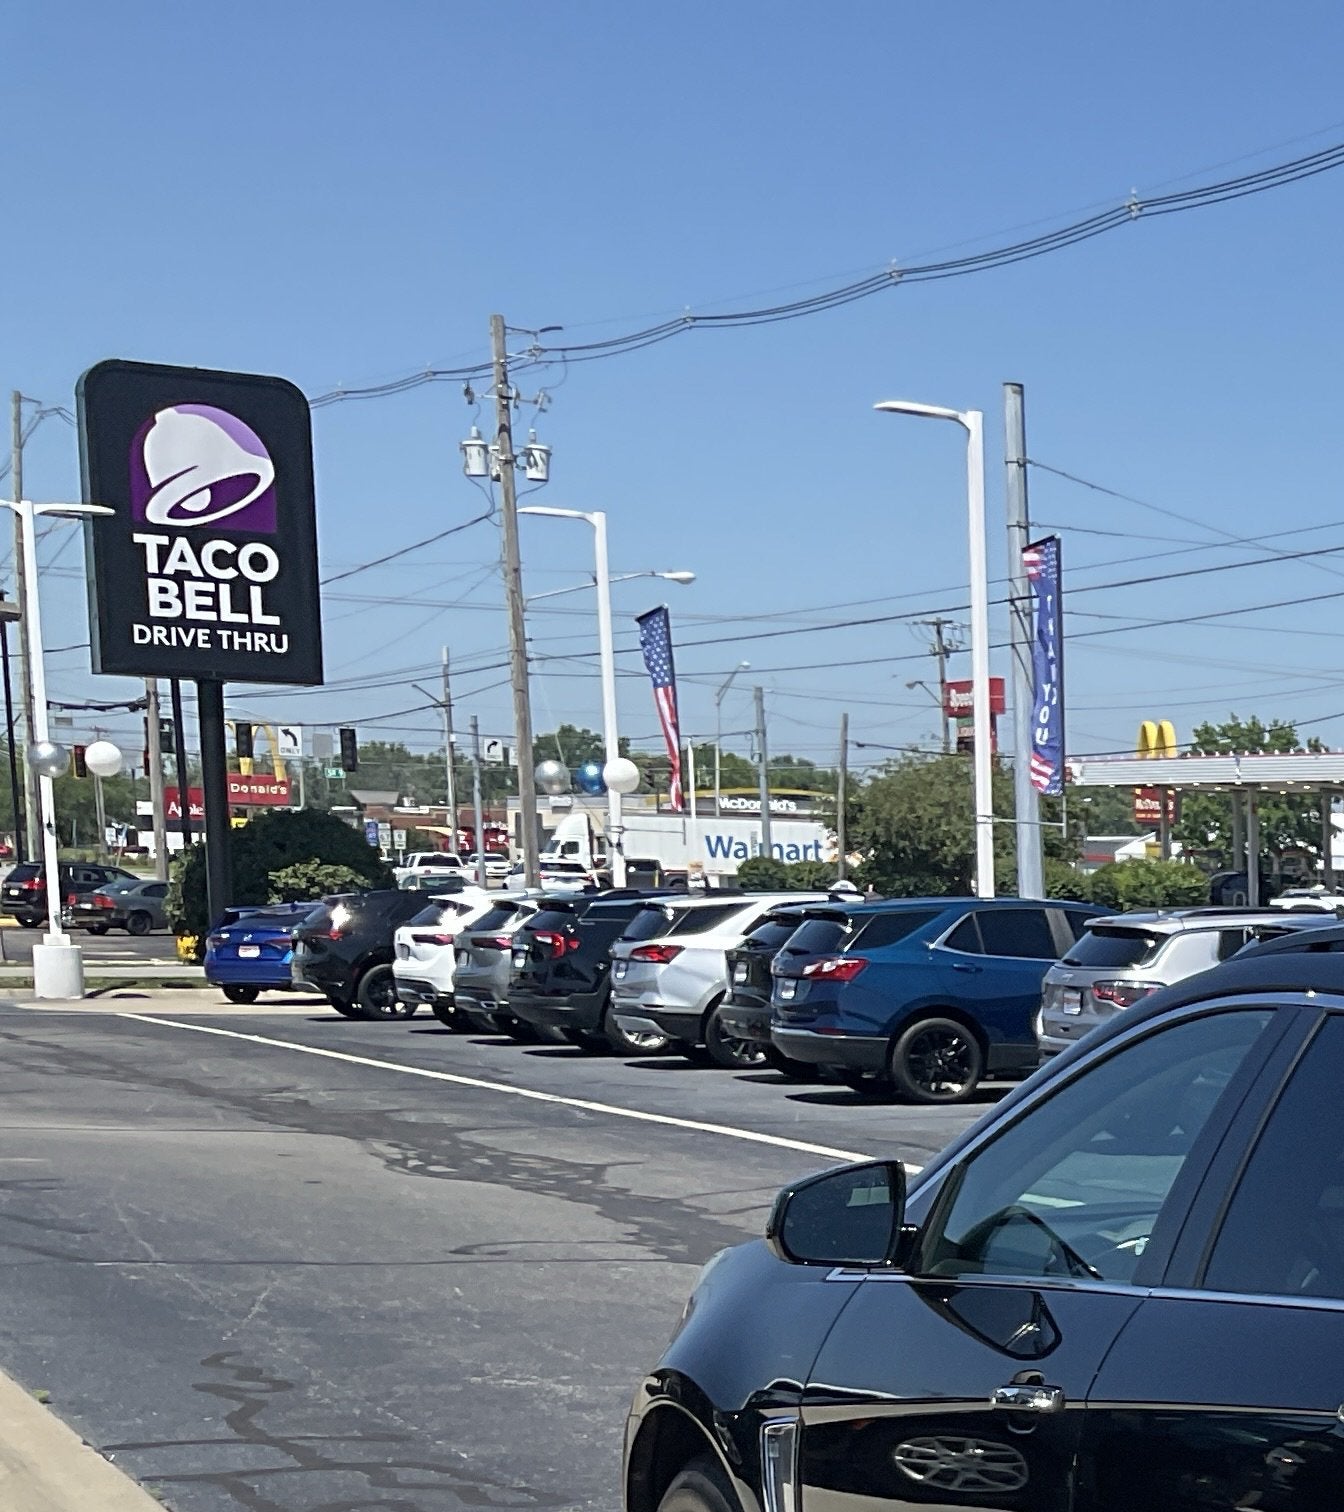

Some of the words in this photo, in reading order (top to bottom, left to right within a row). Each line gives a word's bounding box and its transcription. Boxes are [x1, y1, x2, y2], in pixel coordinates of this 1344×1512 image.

[132, 533, 280, 583] TACO
[147, 577, 281, 626] BELL
[132, 623, 211, 649] DRIVE
[216, 629, 289, 654] THRU
[1036, 683, 1051, 745] YOU
[230, 783, 287, 795] Donald's
[705, 834, 823, 862] Wamart
